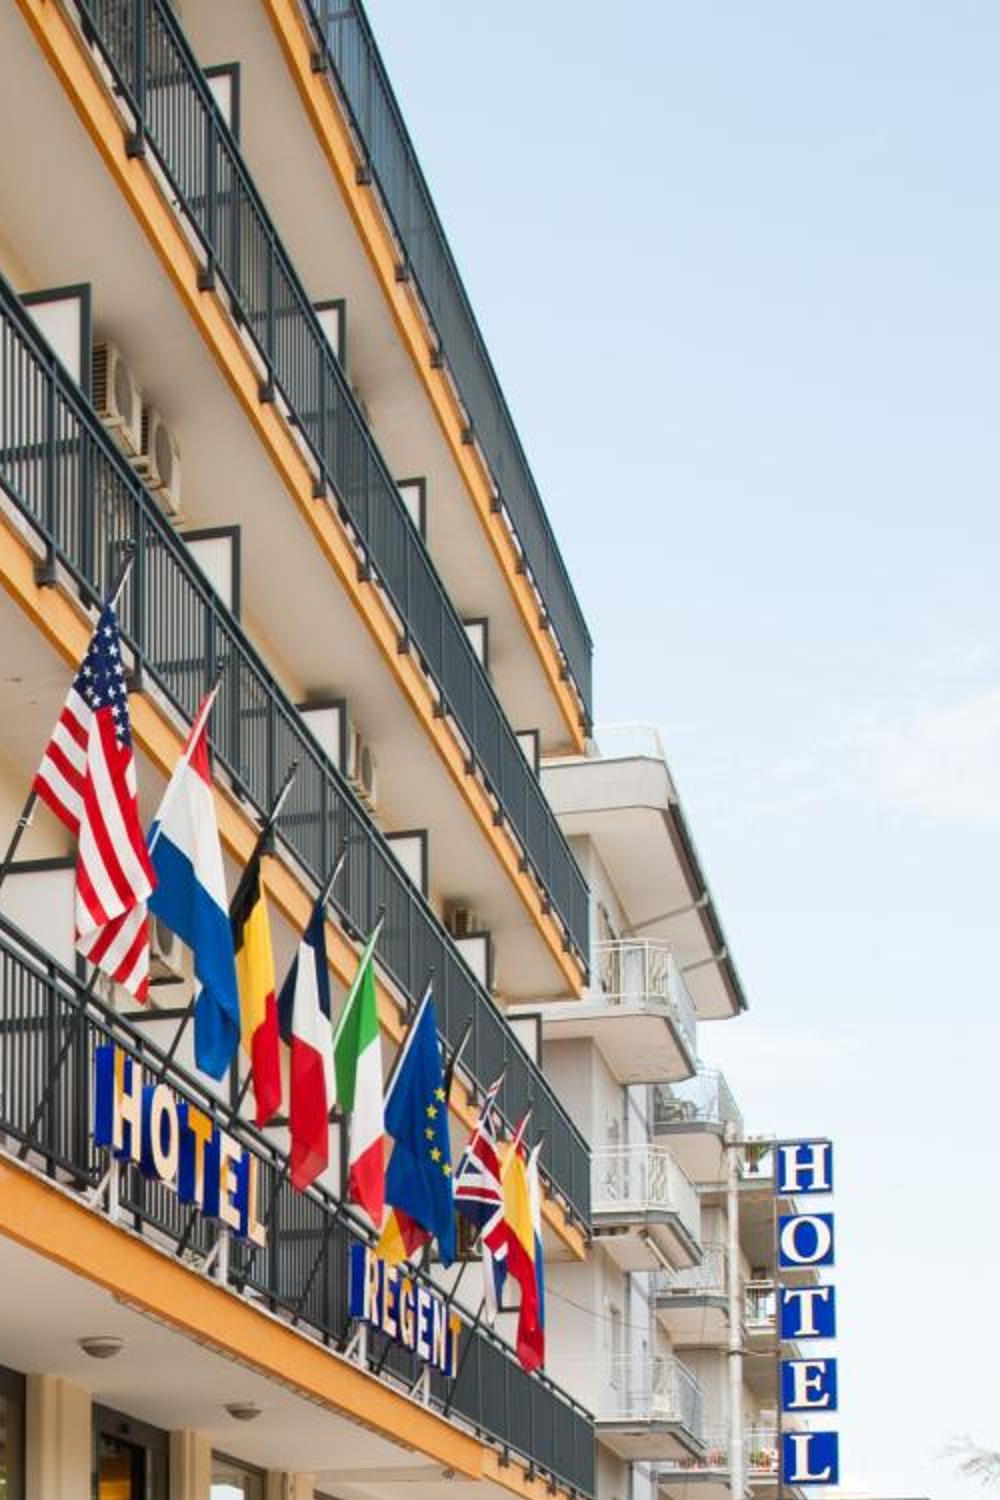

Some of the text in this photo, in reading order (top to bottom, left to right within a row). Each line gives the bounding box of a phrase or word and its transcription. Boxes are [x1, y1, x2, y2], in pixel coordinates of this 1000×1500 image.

[114, 1046, 266, 1248] HOTEL
[364, 1245, 462, 1379] REGENT
[779, 1143, 832, 1482] HOTEL
